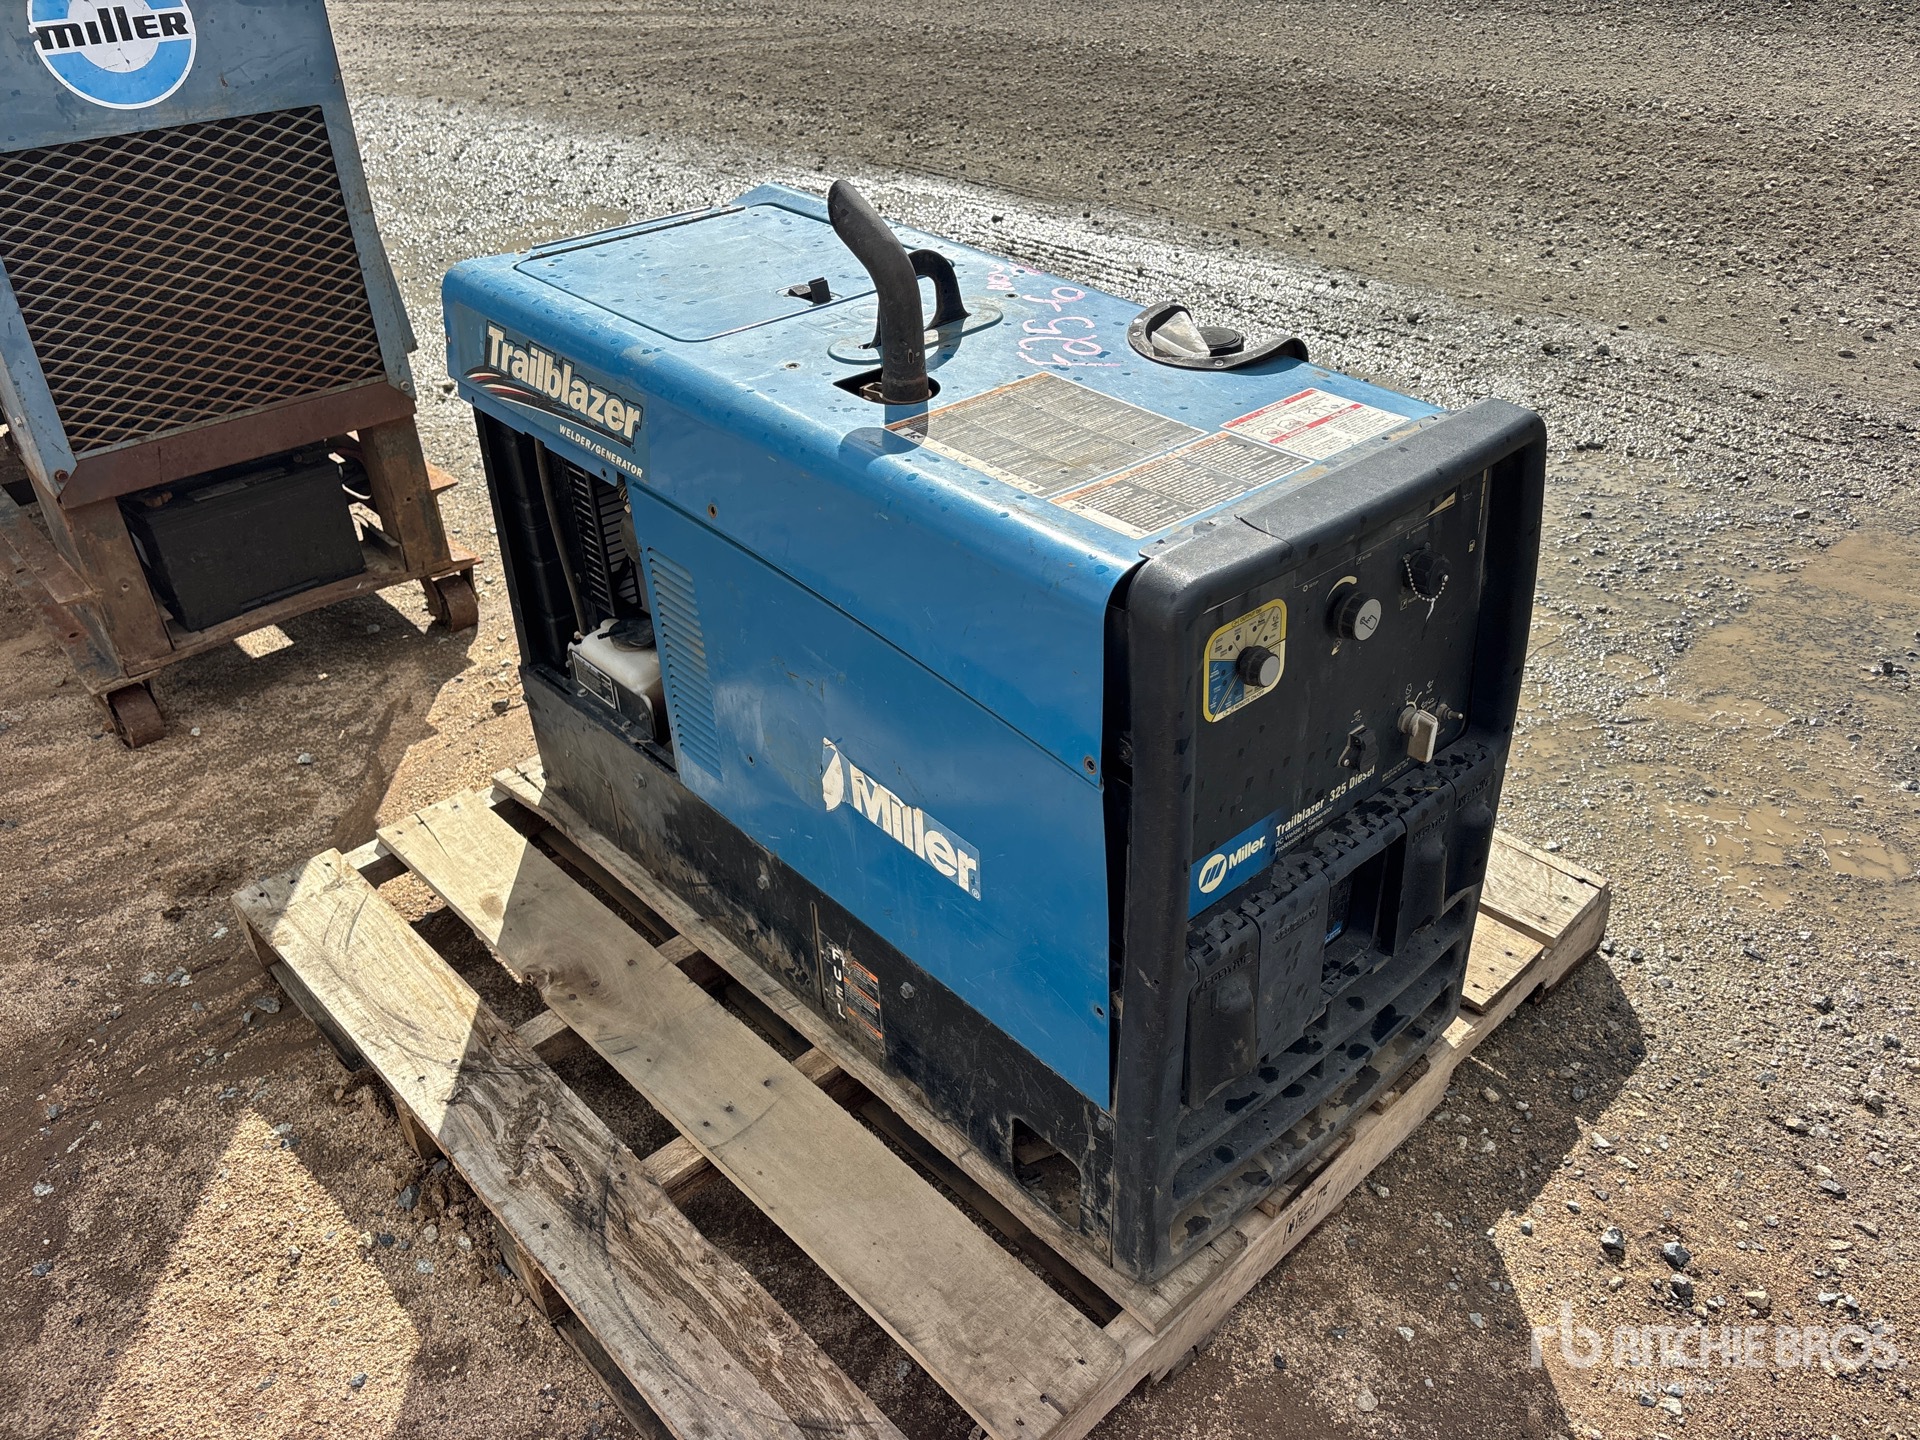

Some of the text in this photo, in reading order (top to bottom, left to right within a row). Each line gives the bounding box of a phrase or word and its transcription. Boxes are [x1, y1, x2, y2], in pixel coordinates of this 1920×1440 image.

[488, 325, 641, 439] Trailblazer
[559, 424, 643, 478] WELDER/GENERATOR
[850, 763, 977, 892] Miller
[1276, 799, 1325, 837] Trailblazer
[1329, 782, 1347, 802] 325
[1349, 764, 1376, 790] Diesel
[1285, 826, 1304, 841] Welder
[1308, 805, 1334, 825] Generator
[1308, 819, 1324, 833] Series
[1228, 836, 1265, 869] Miller
[831, 947, 846, 1019] FUEL
